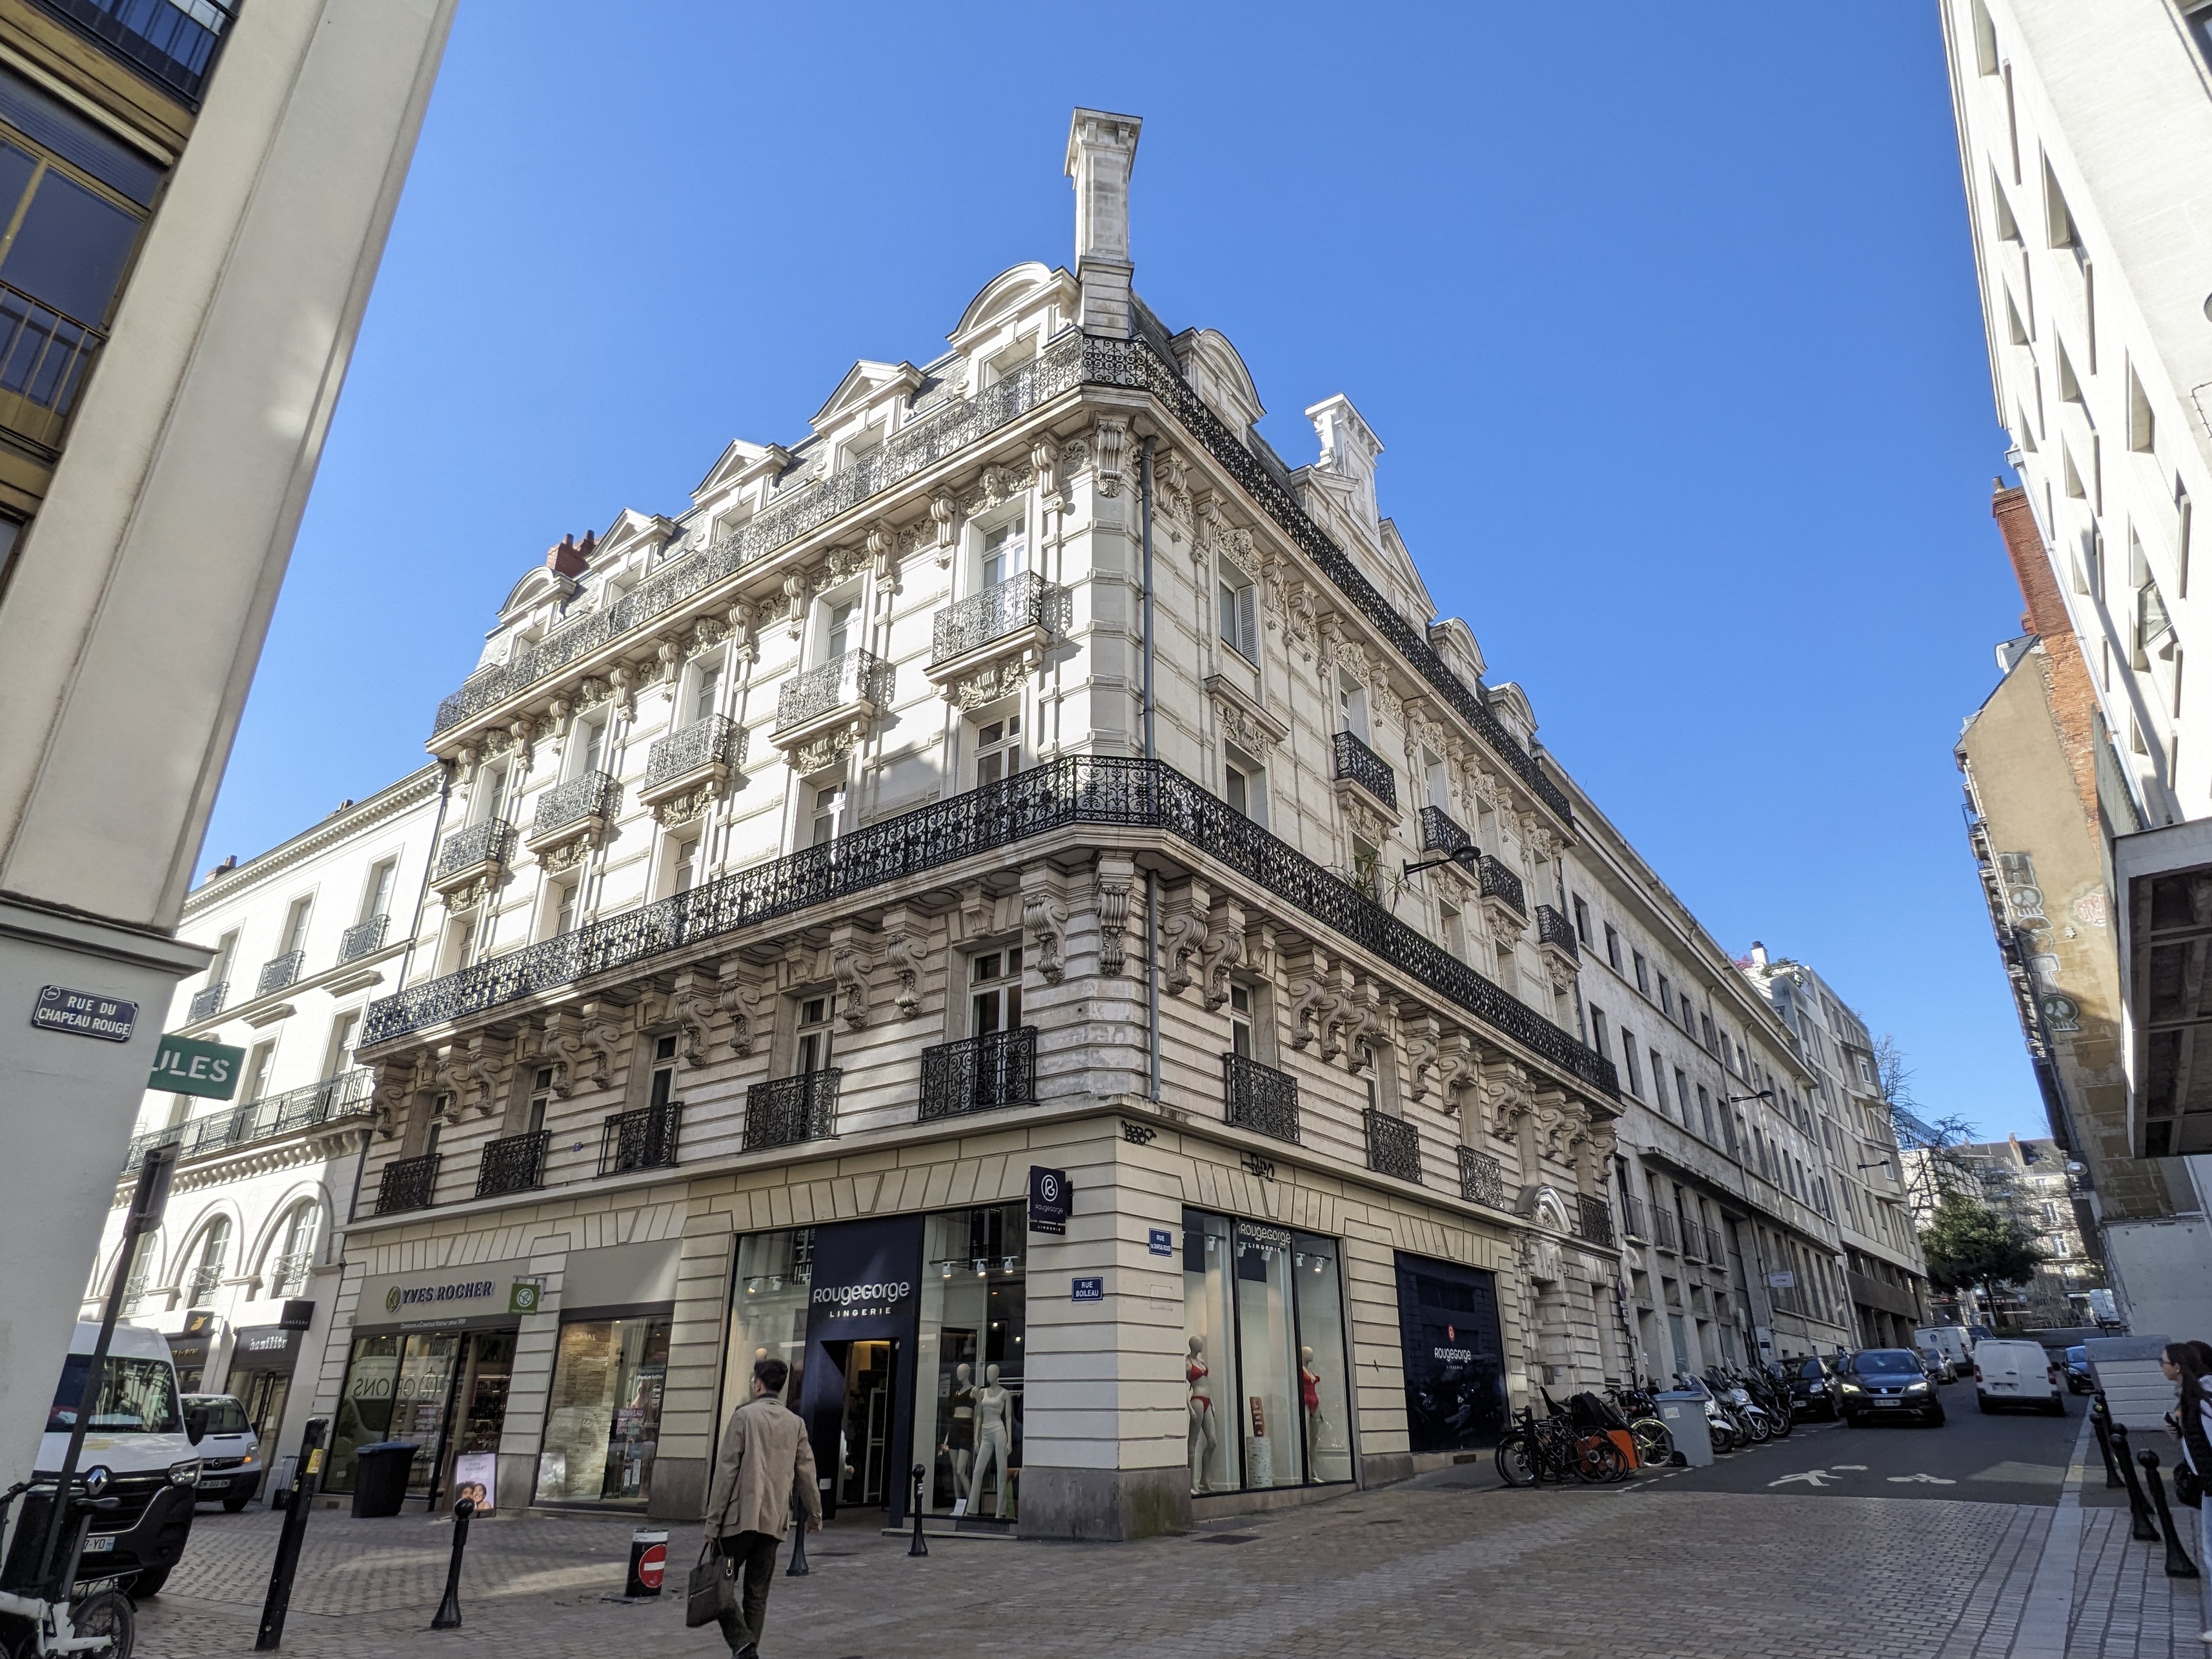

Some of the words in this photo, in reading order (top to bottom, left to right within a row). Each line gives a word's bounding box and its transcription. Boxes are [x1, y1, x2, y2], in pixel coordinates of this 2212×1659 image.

[67, 996, 94, 1011] RUE
[99, 1003, 117, 1015] DU
[38, 1008, 91, 1027] CHAPEAU
[92, 1017, 130, 1035] ROUGE
[1248, 1242, 1281, 1253] LINGERIE
[403, 1287, 434, 1304] YVES
[437, 1281, 493, 1301] ROCHER
[1075, 1289, 1099, 1298] BOILEAU
[829, 1307, 892, 1318] LINGERIE
